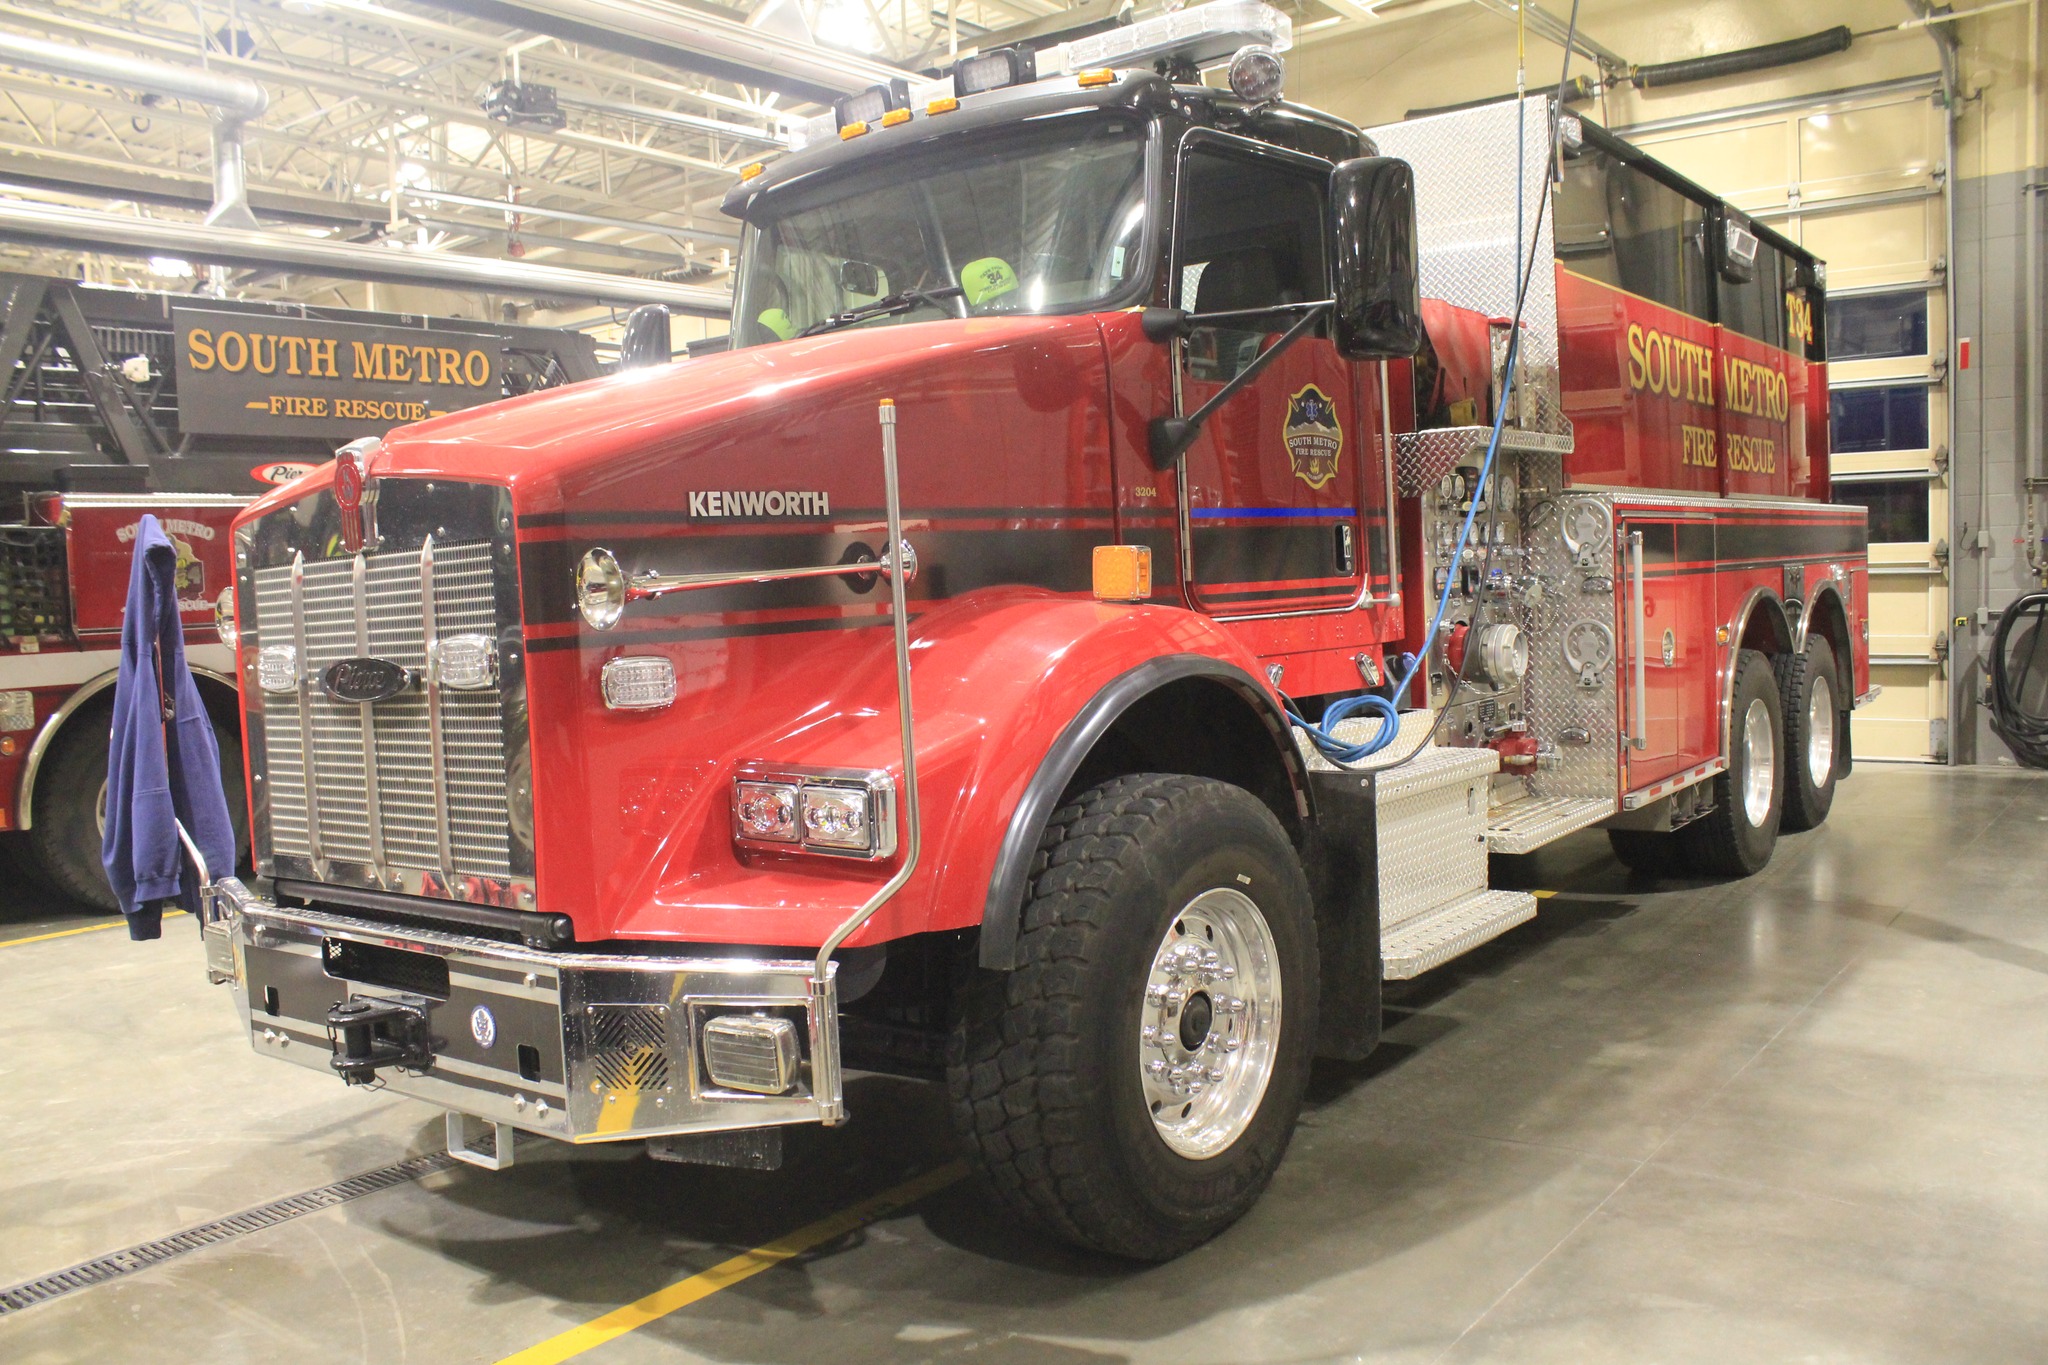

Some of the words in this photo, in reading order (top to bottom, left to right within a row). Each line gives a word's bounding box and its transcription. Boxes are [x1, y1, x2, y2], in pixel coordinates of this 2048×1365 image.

[400, 315, 412, 324] 95
[1786, 290, 1813, 345] T34
[188, 328, 340, 378] SOUTH
[351, 341, 490, 387] METRO
[1627, 322, 1716, 406] SOUTH
[1723, 354, 1789, 423] METRO
[269, 395, 329, 417] FIRE
[334, 398, 427, 421] RESCUE
[1288, 436, 1312, 448] SOUTH
[1313, 436, 1338, 450] METRO
[1295, 447, 1309, 456] FIRE
[1309, 448, 1332, 457] RESCUE
[1681, 424, 1718, 468] FIRE
[1726, 432, 1776, 474] RESCUE
[688, 490, 830, 517] KENWORTH
[1135, 486, 1157, 497] 3204
[166, 518, 215, 541] METRO
